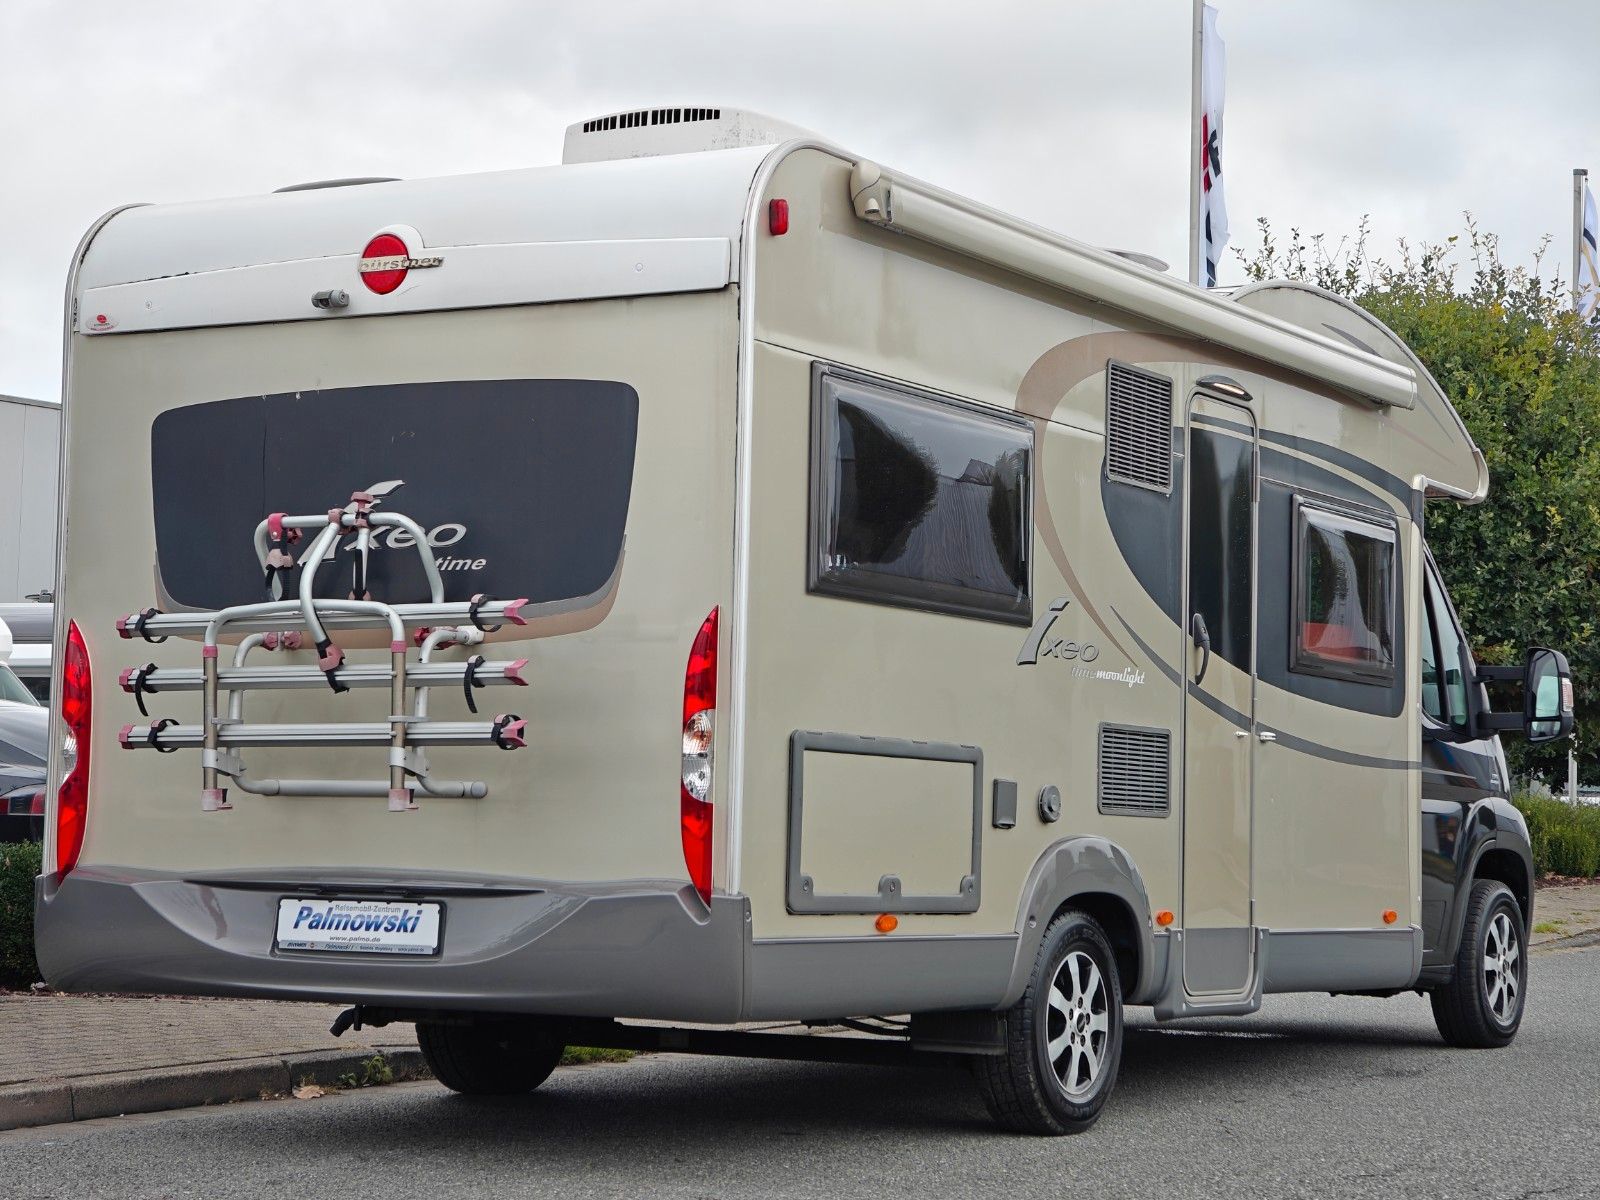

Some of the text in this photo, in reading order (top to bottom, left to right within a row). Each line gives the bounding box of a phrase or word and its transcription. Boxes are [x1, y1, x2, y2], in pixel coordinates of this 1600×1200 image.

[435, 555, 487, 571] time
[1096, 667, 1146, 688] moonlight
[293, 905, 423, 934] Palmowski
[329, 935, 381, 944] www.palmo.de
